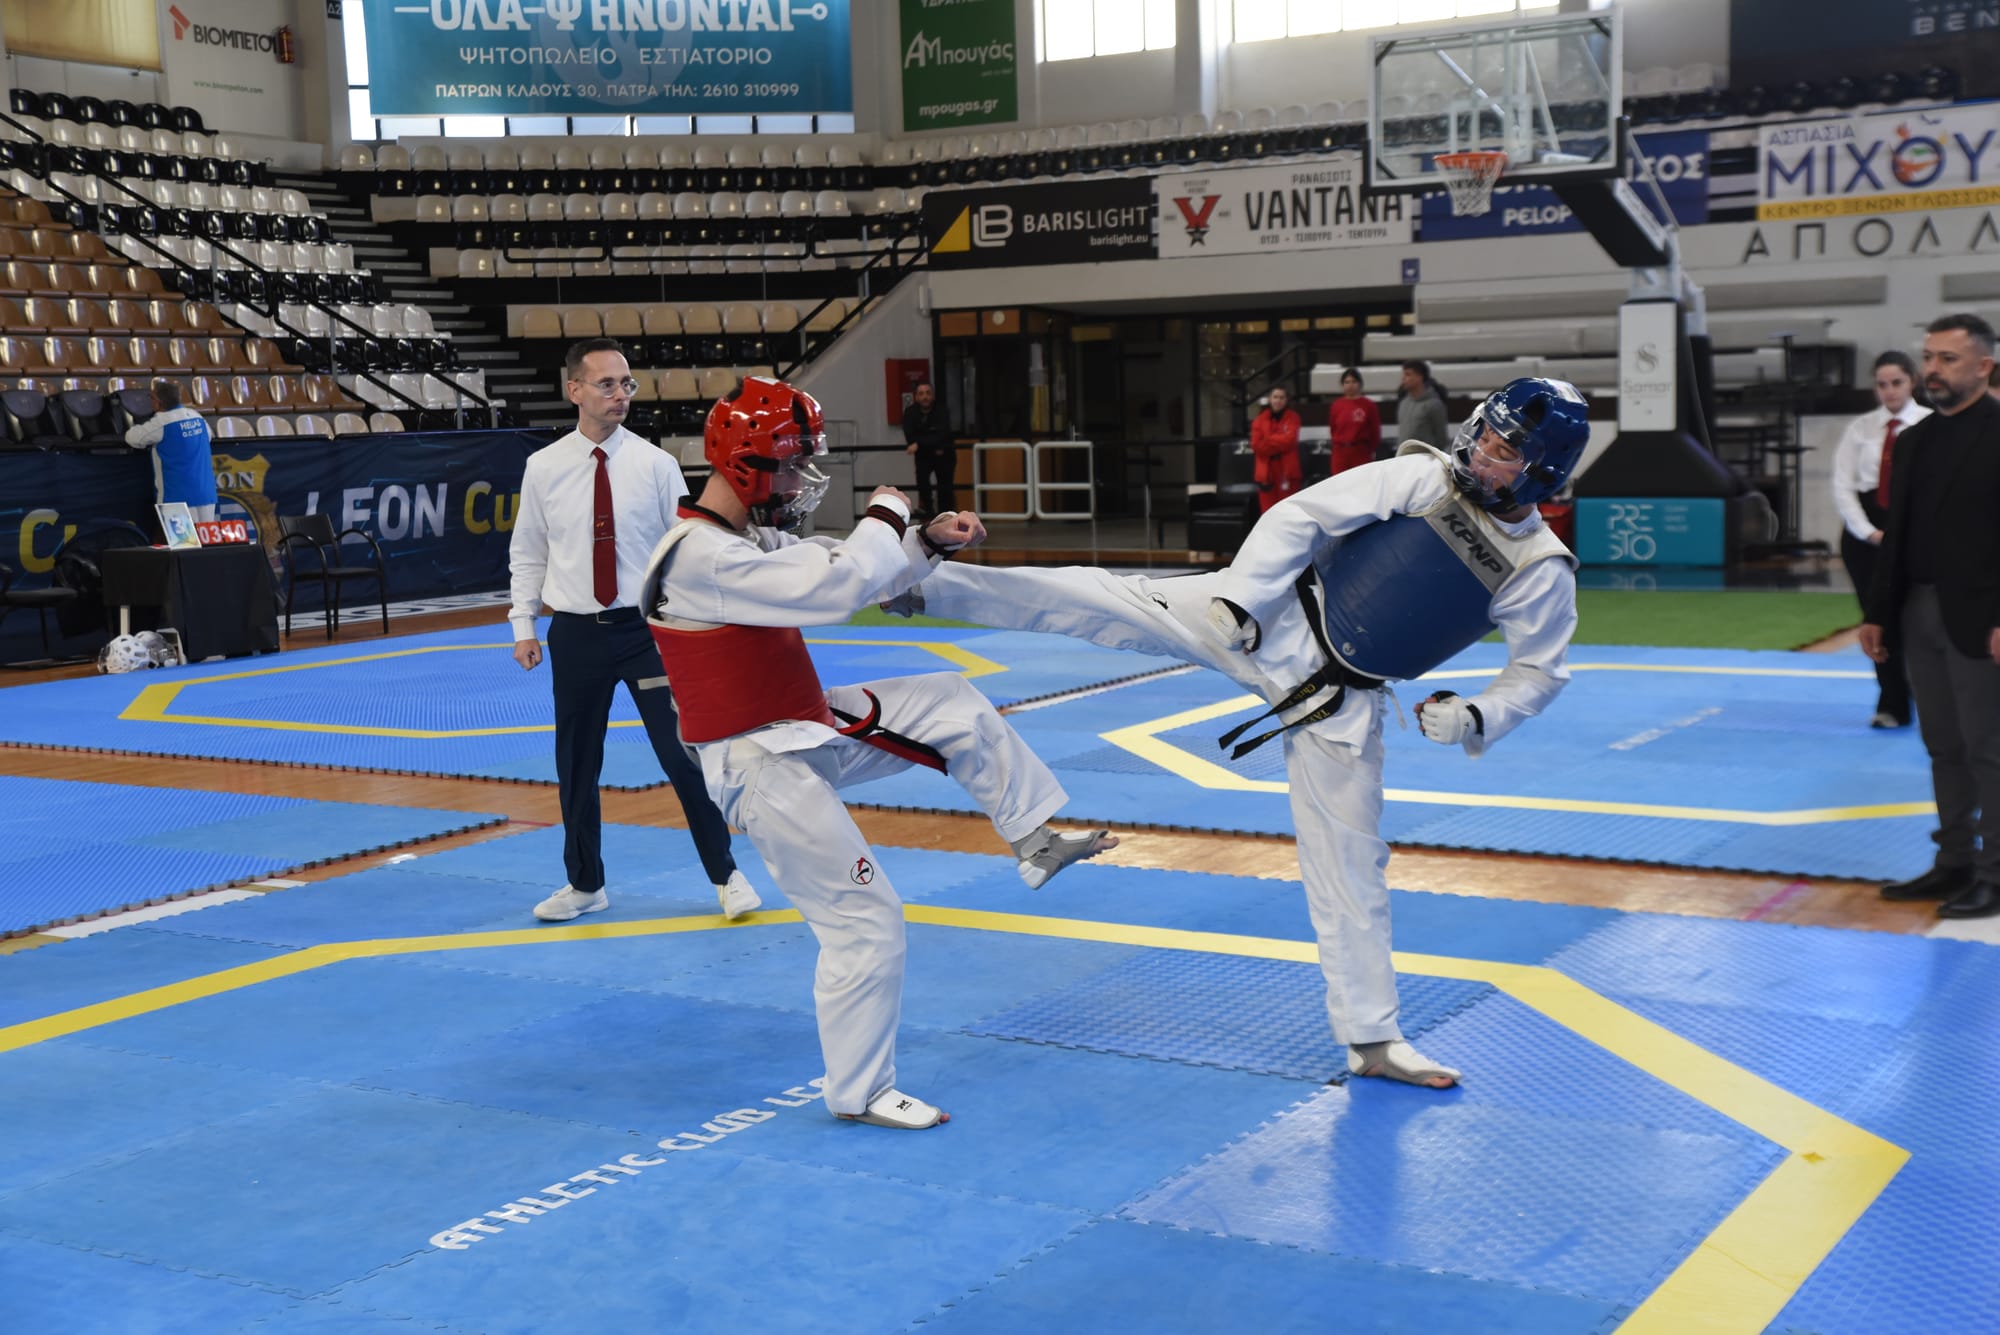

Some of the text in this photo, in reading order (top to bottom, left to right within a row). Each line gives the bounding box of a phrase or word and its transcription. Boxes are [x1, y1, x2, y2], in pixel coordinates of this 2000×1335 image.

[460, 47, 772, 65] ΨΗΤΟΠΩΛΕΙΟ ΕΣΤΙΑΤΟΡΙΟ
[435, 84, 799, 98] ΠΑΤΡΩΝ ΚΛΑΟΥΣ 30, ΠΑΤΡΑ ΤΗΛ: 2610 310999
[919, 99, 999, 118] mpougas.gr
[1769, 125, 1856, 145] ΑΣΠΑΣΙΑ
[1245, 184, 1403, 231] VANTANA
[1766, 203, 1837, 218] ΚΕΝΤΡΟ
[1023, 206, 1149, 233] BARISLIGHT
[1090, 234, 1149, 247] barislight.eu
[464, 481, 521, 535] Cu
[1441, 513, 1503, 573] KPNP
[429, 1153, 668, 1250] ATHLETIC
[657, 1108, 777, 1151] CLUB
